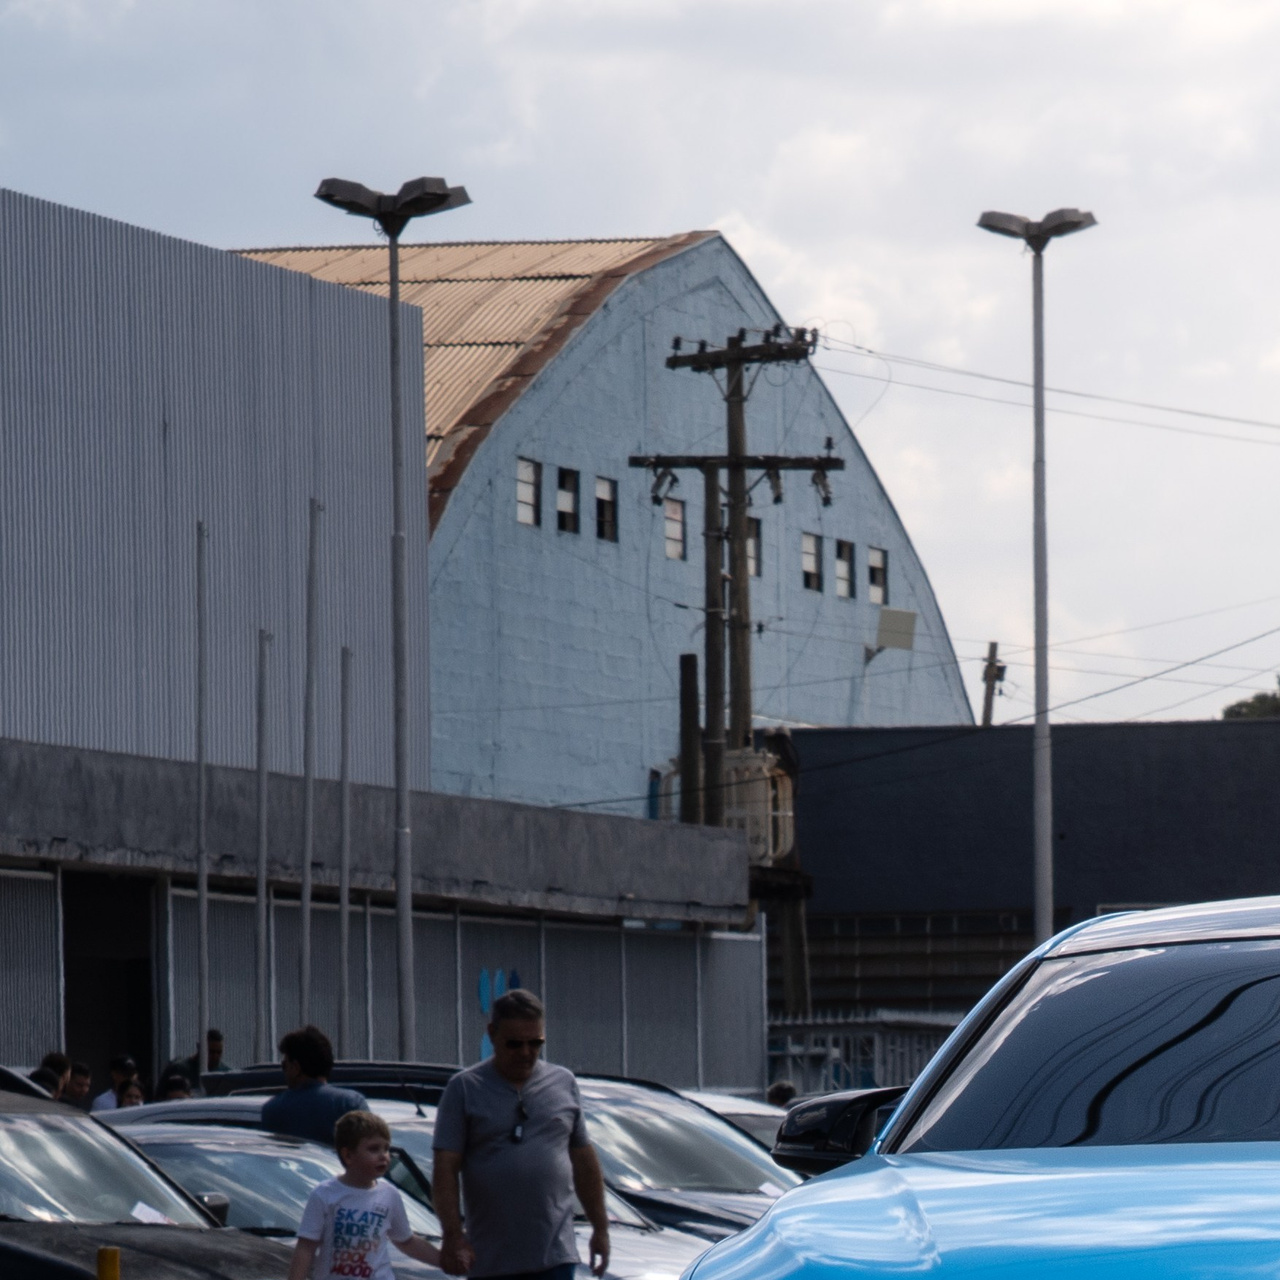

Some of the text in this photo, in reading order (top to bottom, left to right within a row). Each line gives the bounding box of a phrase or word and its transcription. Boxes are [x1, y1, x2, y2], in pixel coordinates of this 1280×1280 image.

[336, 1208, 383, 1228] SKATE
[335, 1222, 370, 1238] RIDE
[334, 1235, 380, 1252] ENJOY
[333, 1250, 367, 1266] COOL
[331, 1263, 372, 1278] MOOD
